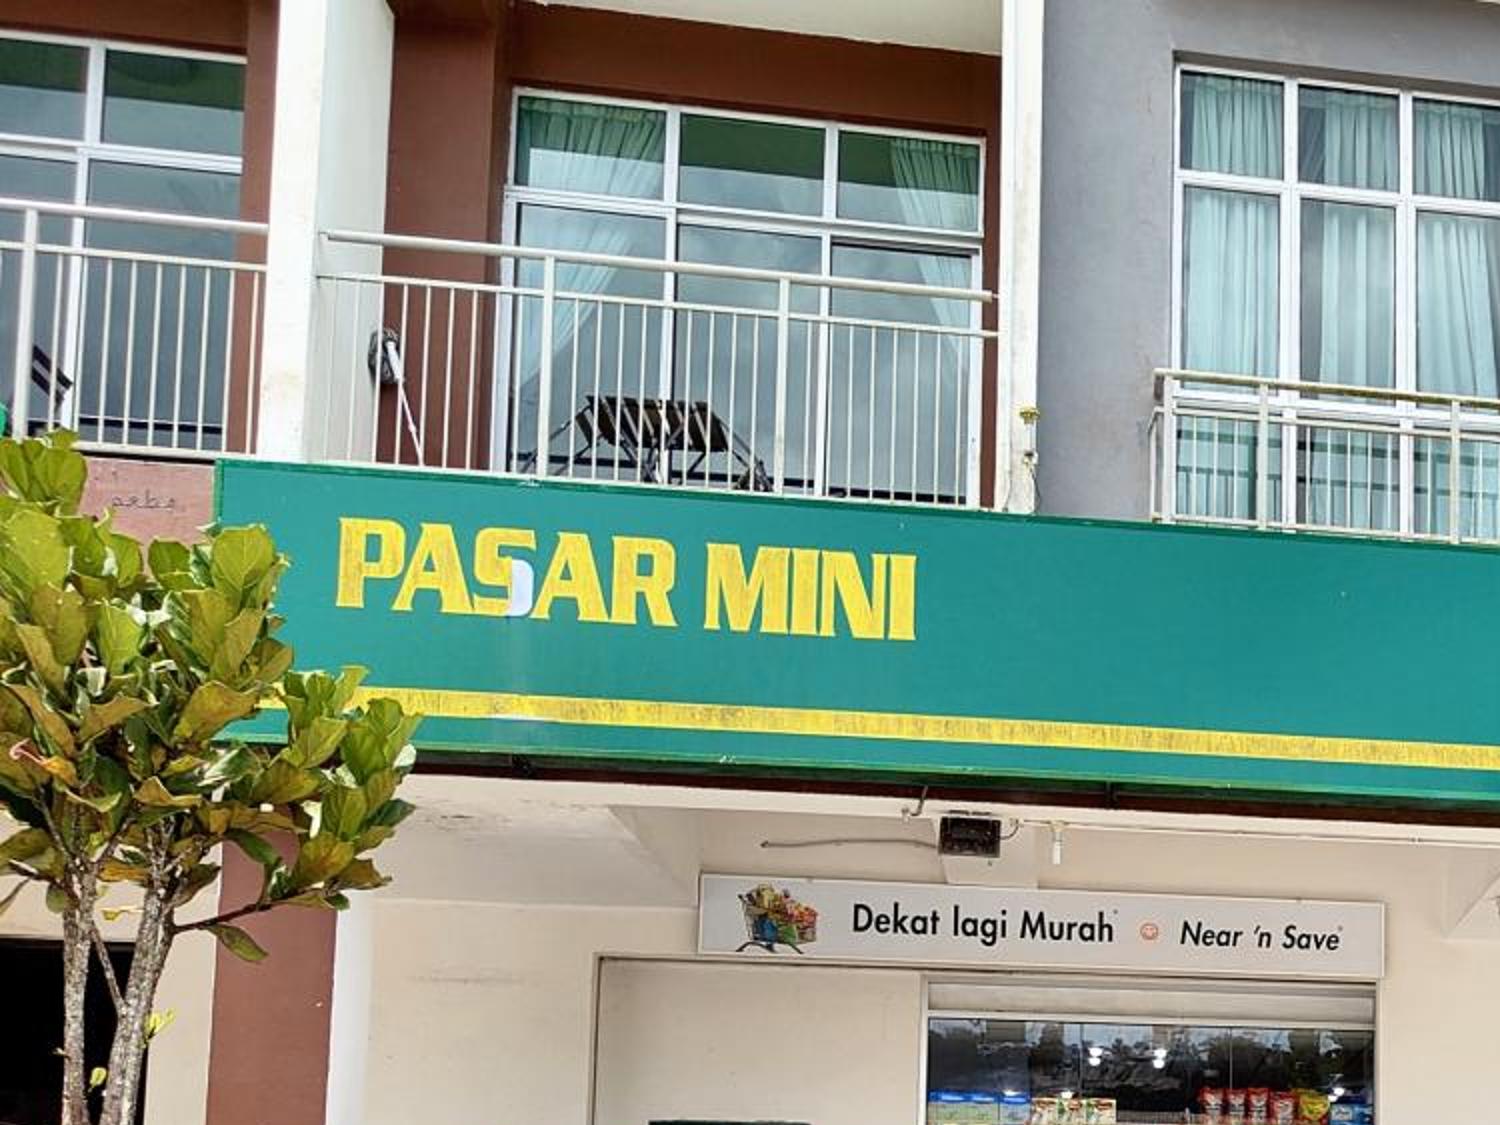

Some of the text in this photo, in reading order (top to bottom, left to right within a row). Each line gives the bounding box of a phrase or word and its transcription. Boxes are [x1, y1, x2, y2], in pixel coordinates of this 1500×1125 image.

[335, 517, 918, 641] PASAR MINI
[853, 903, 1114, 947] Dekat lagi Murah
[1181, 921, 1241, 948] Near
[1282, 924, 1341, 951] Save
